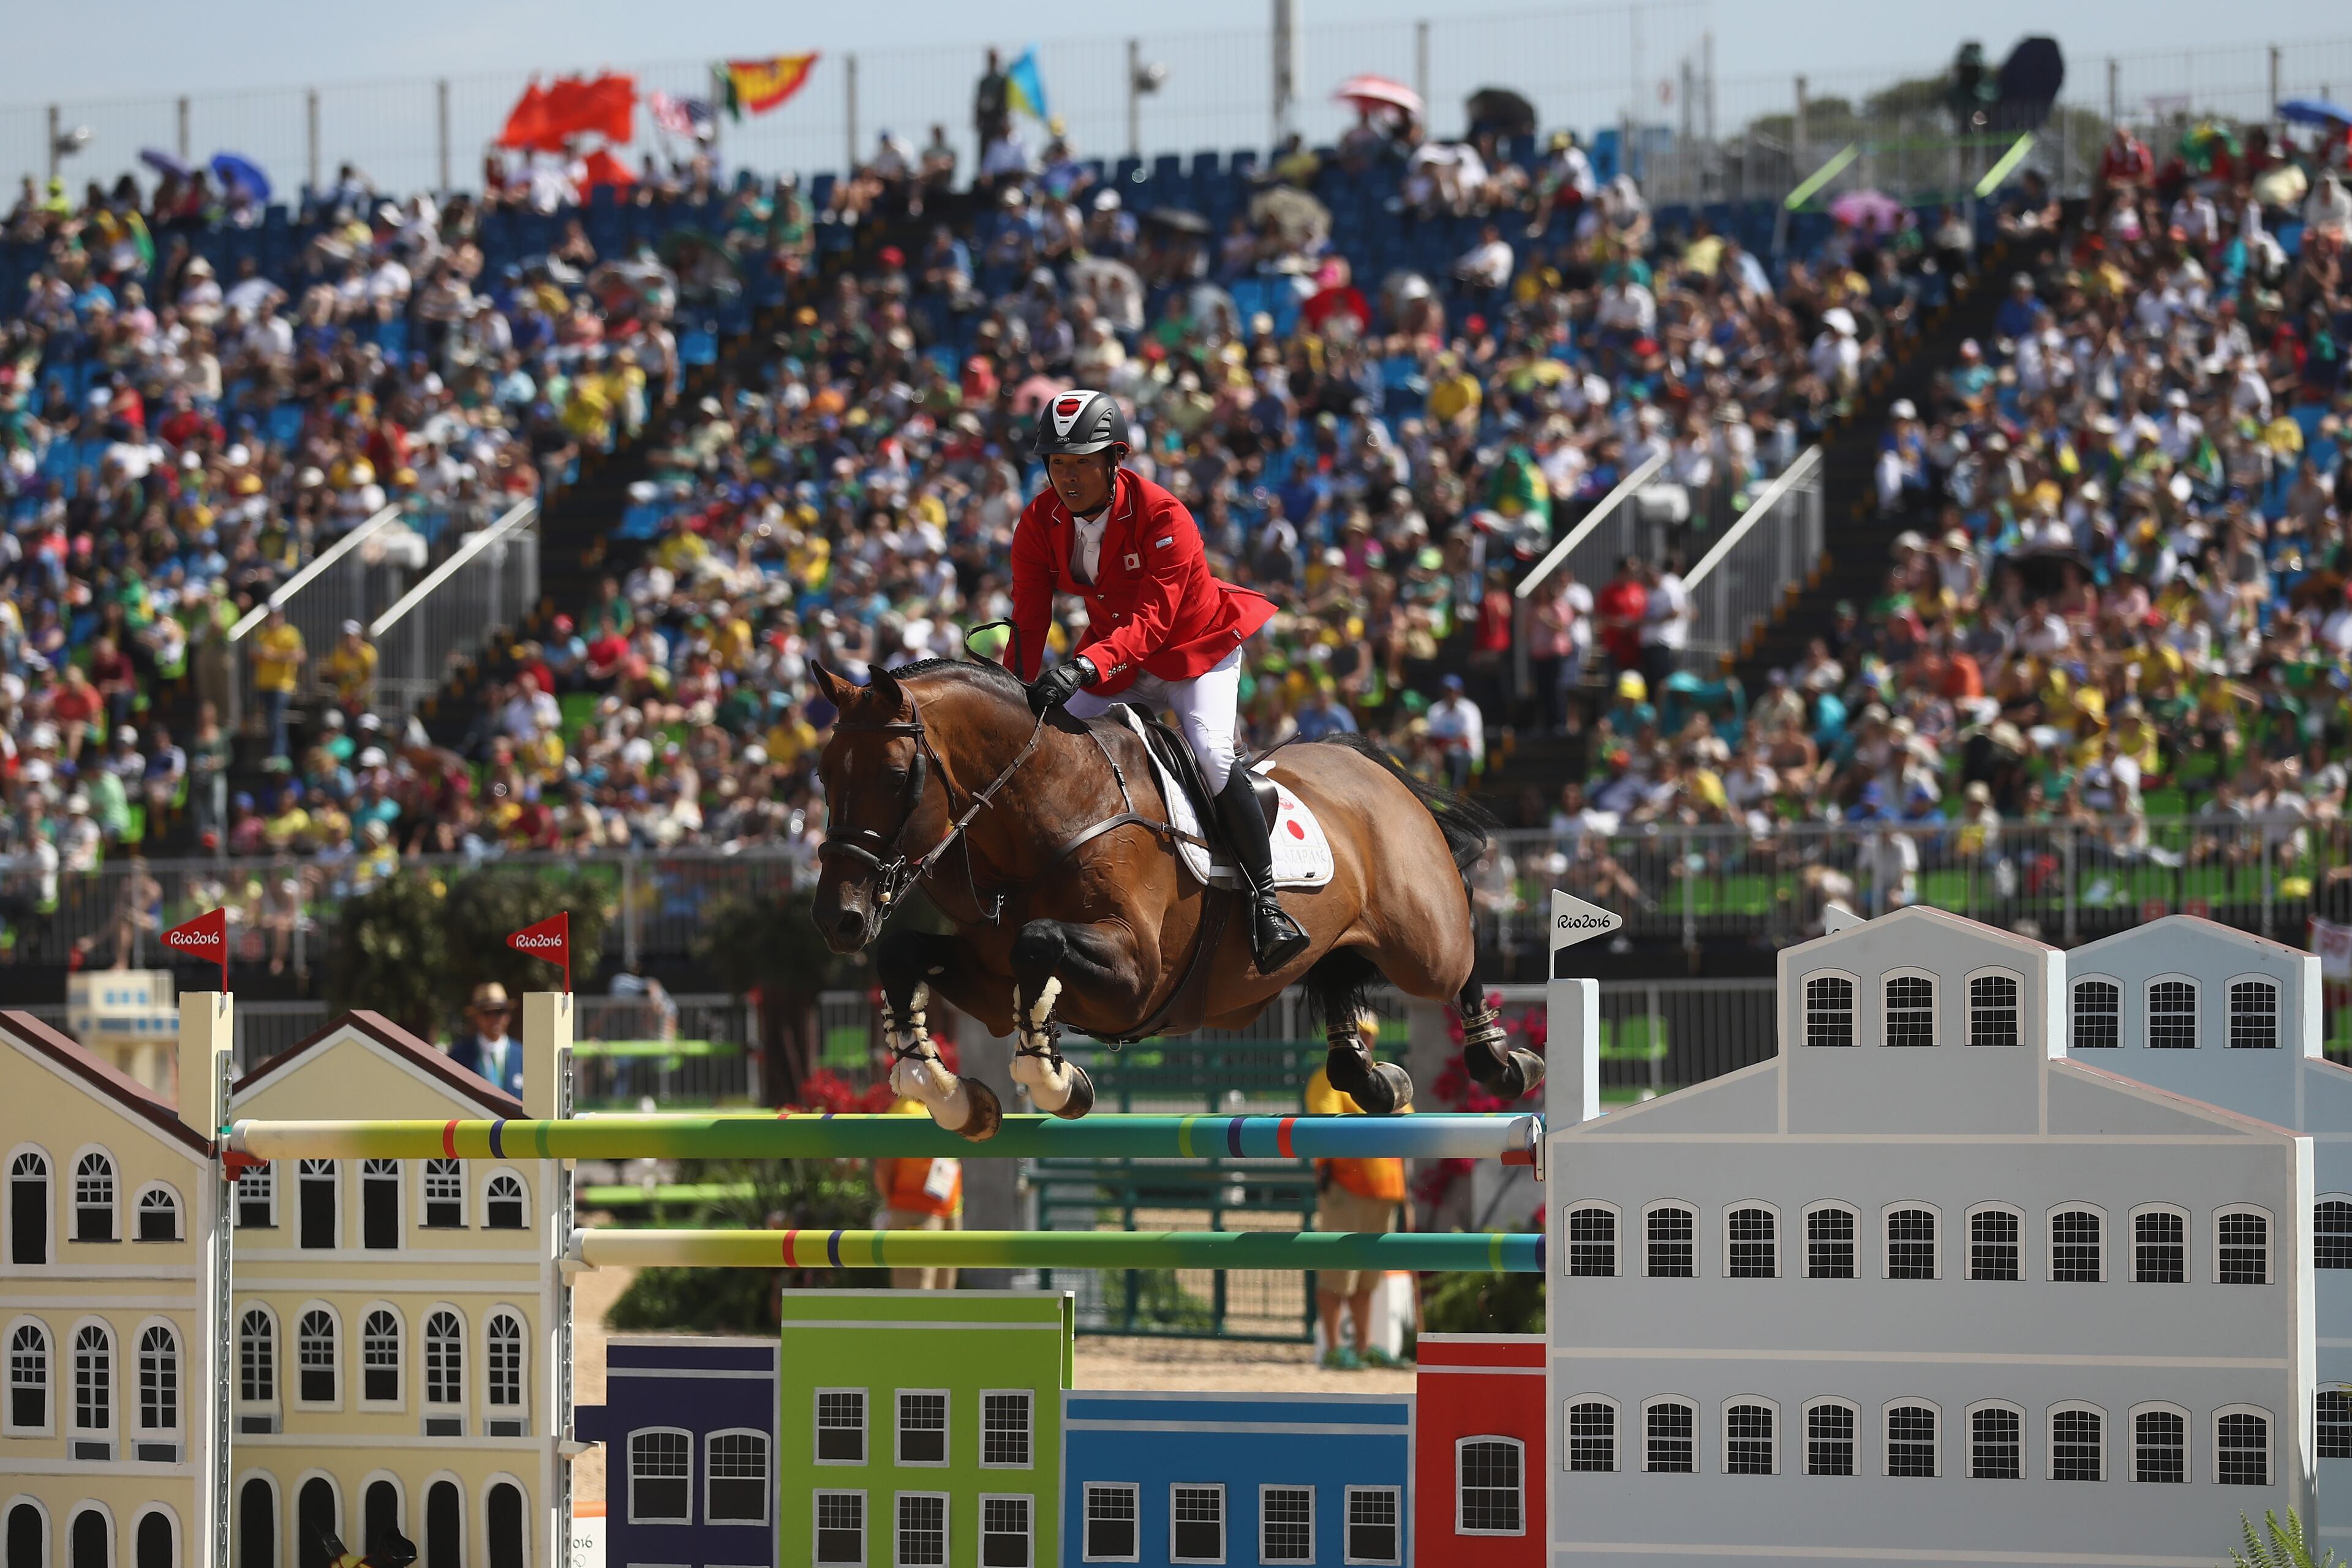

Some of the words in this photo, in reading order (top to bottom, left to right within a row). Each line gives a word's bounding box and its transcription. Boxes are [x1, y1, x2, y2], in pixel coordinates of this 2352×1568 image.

[1289, 850, 1324, 864] JAPAN
[1557, 914, 1611, 929] Rio2016
[170, 930, 219, 945] Rio2016
[516, 933, 562, 948] Rio2016
